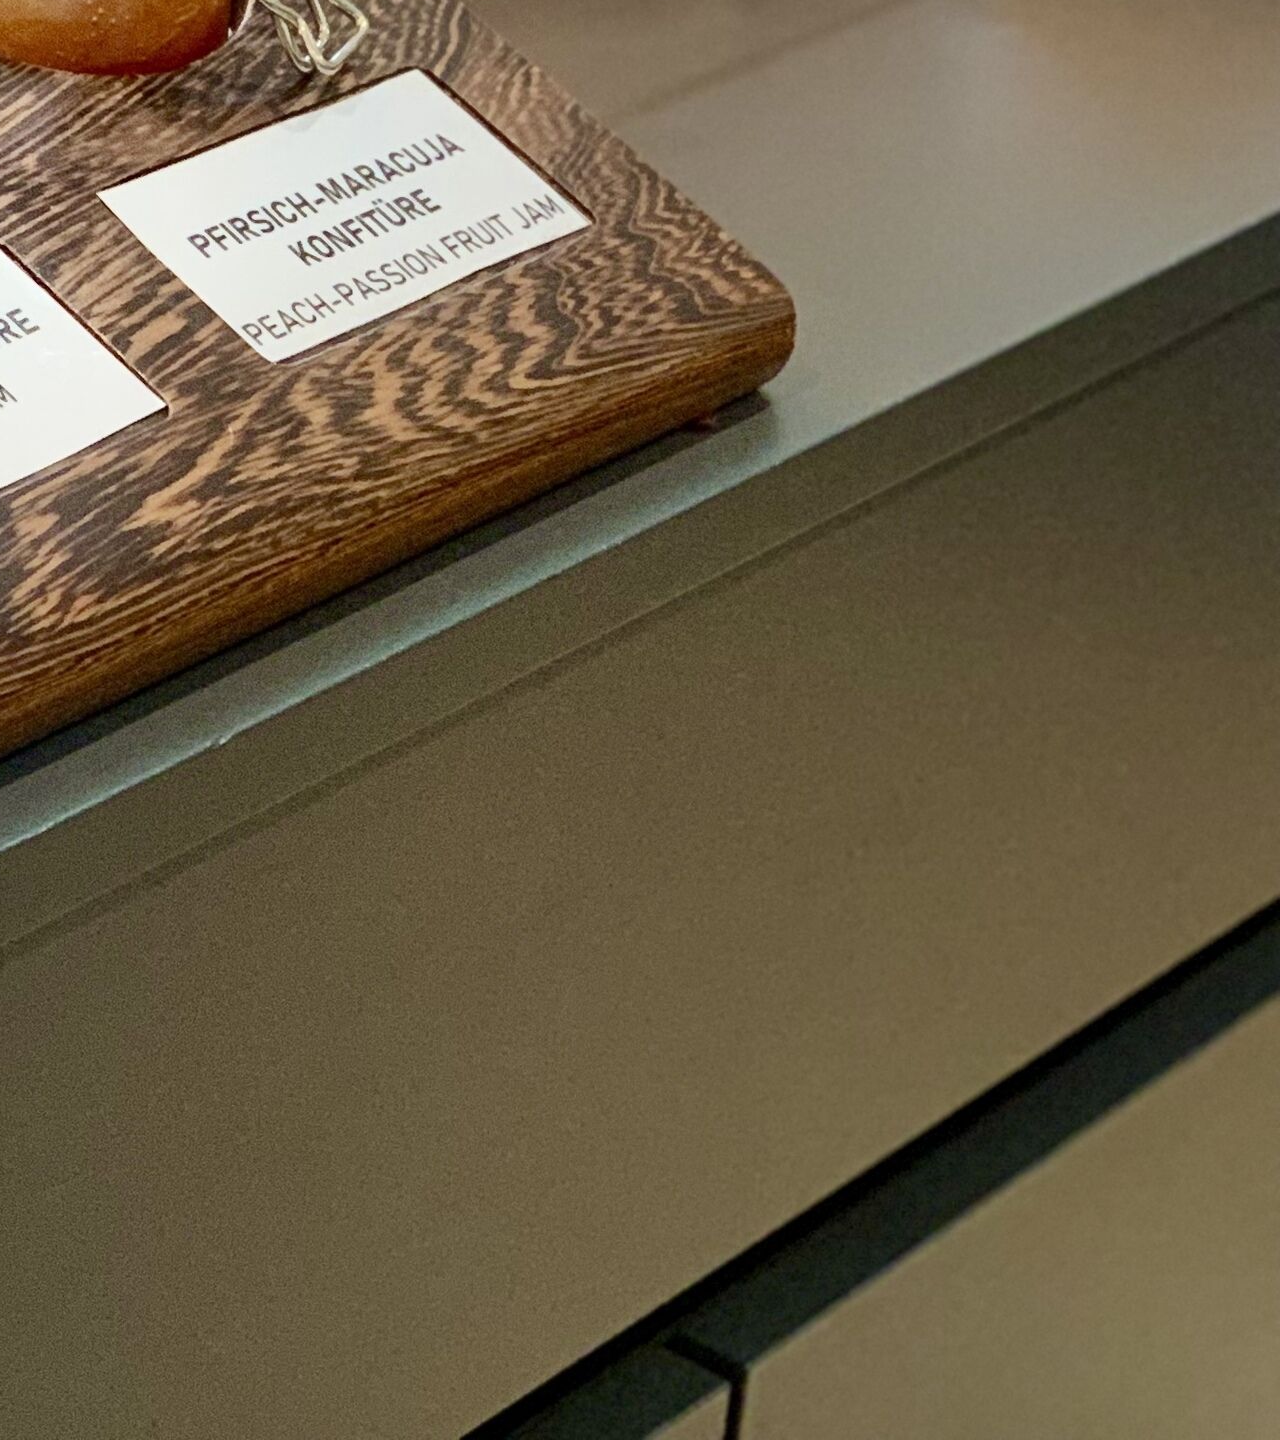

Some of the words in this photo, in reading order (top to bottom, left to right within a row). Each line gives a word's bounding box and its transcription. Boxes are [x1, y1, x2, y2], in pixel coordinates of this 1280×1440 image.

[186, 132, 466, 258] PFIRSICH-MARACUJA
[287, 188, 442, 266] KONFITÜRE
[241, 244, 446, 347] PEACH-PASSION
[439, 213, 514, 260] FRUIT
[517, 194, 566, 231] JAM
